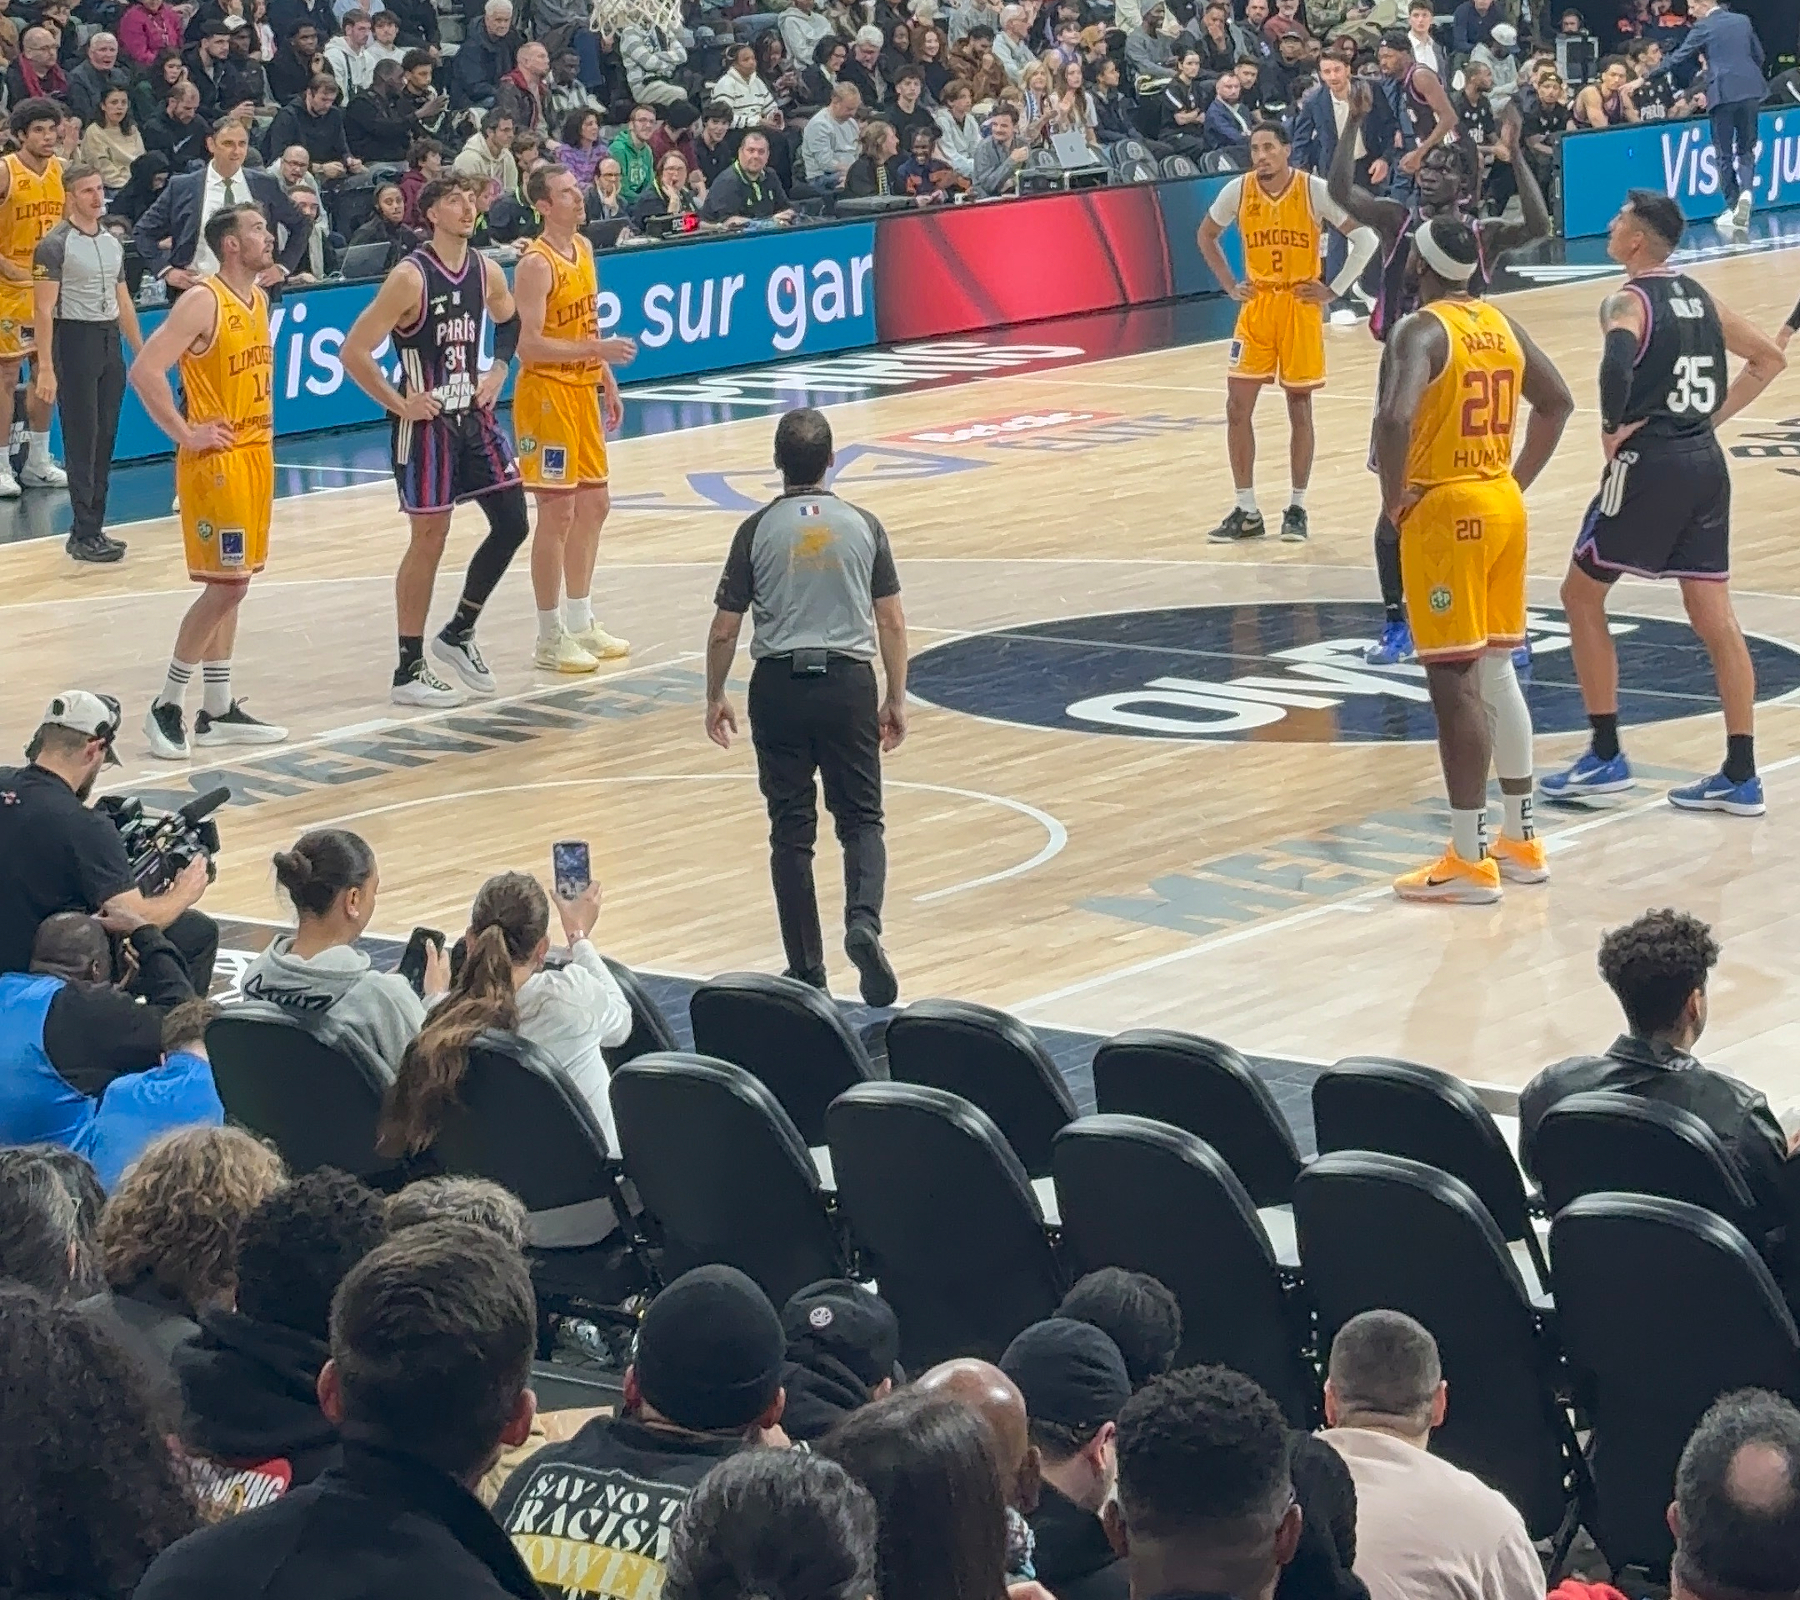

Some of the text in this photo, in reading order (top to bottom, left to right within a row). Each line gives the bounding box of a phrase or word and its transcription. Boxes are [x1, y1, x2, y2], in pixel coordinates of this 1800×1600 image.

[15, 199, 64, 221] LIMOGE
[1245, 228, 1310, 250] LIMOGES
[1271, 249, 1283, 273] 2
[640, 274, 745, 347] sur
[767, 253, 873, 351] gar
[436, 312, 476, 346] PARIS
[1461, 331, 1507, 355] WARE
[445, 344, 466, 371] 34
[619, 340, 1087, 406] PARIS
[1666, 355, 1717, 414] 35
[1461, 368, 1515, 438] 20
[1455, 519, 1482, 542] 20
[529, 1472, 598, 1503] SAY
[594, 1483, 649, 1515] NO
